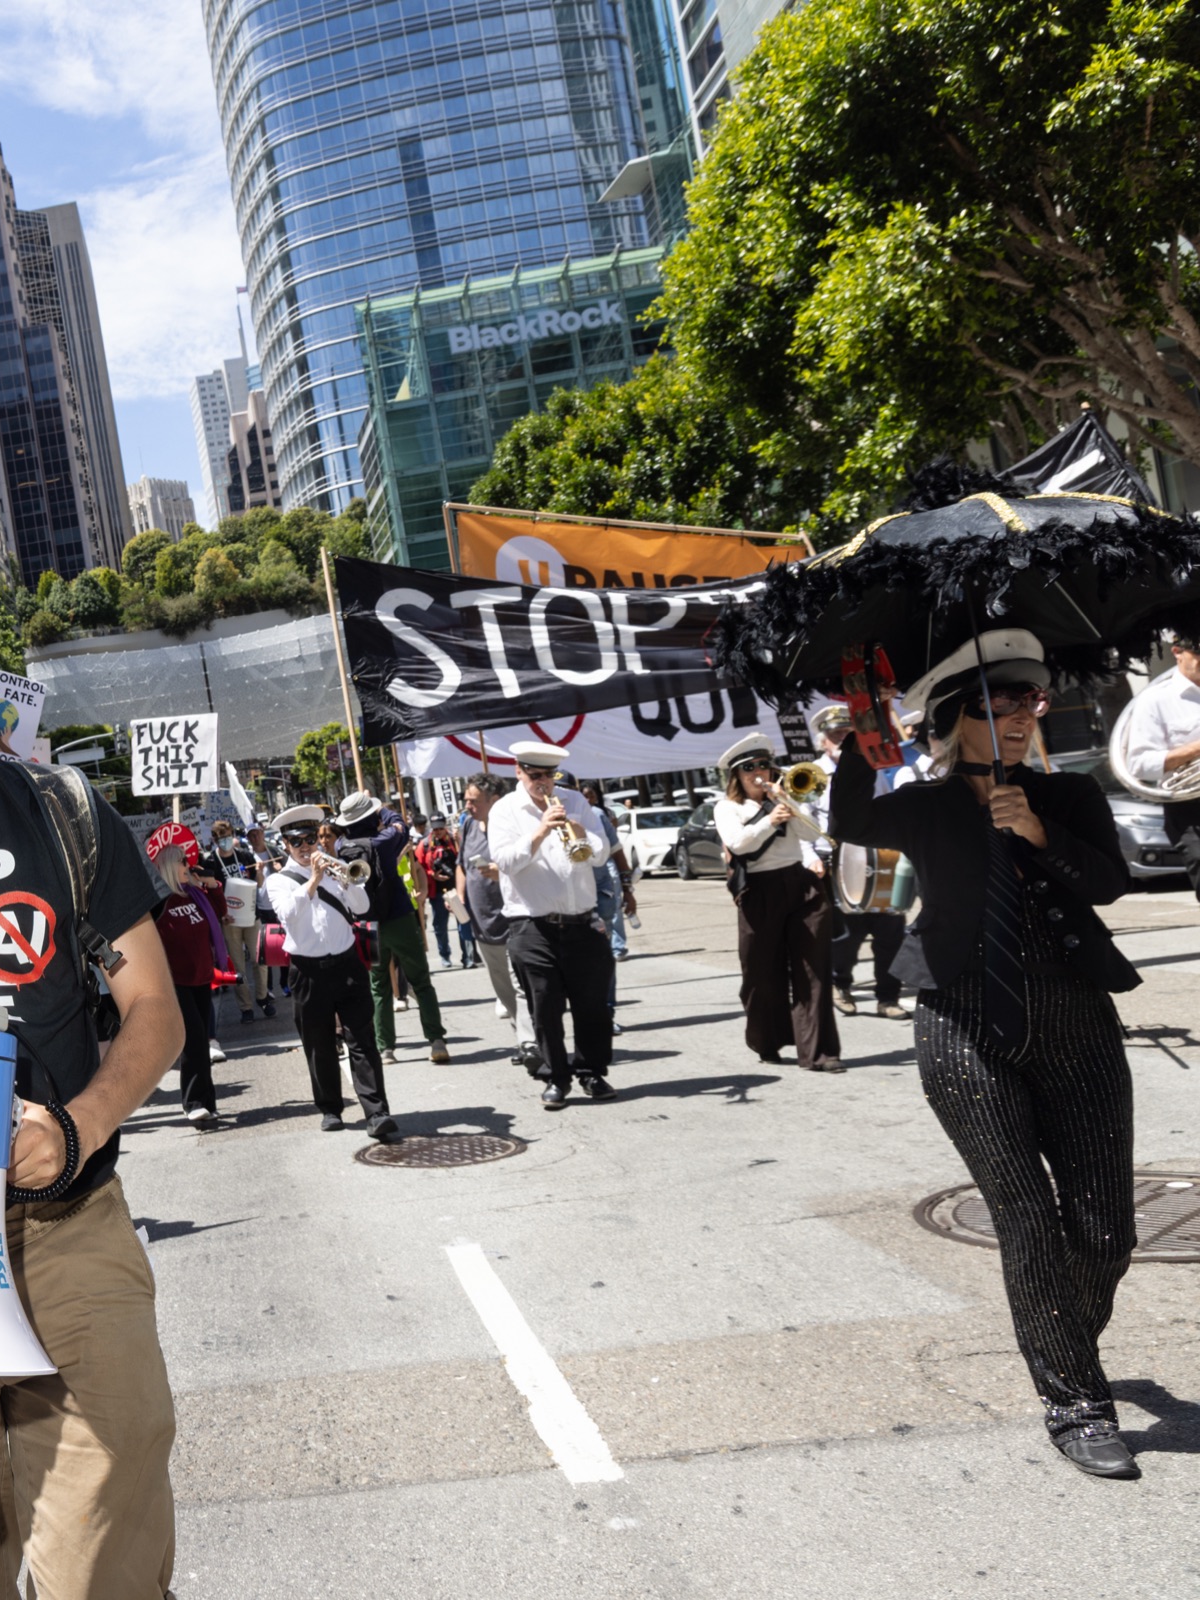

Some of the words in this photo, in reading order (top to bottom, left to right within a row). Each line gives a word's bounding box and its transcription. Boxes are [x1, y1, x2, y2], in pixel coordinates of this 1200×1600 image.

[448, 299, 624, 355] BlackRock
[375, 587, 687, 708] STOP
[4, 688, 37, 707] FATE.
[136, 720, 199, 746] FUCK
[138, 744, 195, 766] THIS
[142, 761, 208, 791] SHIT
[146, 824, 182, 860] STOP
[168, 903, 197, 917] STOP
[189, 912, 204, 924] AI
